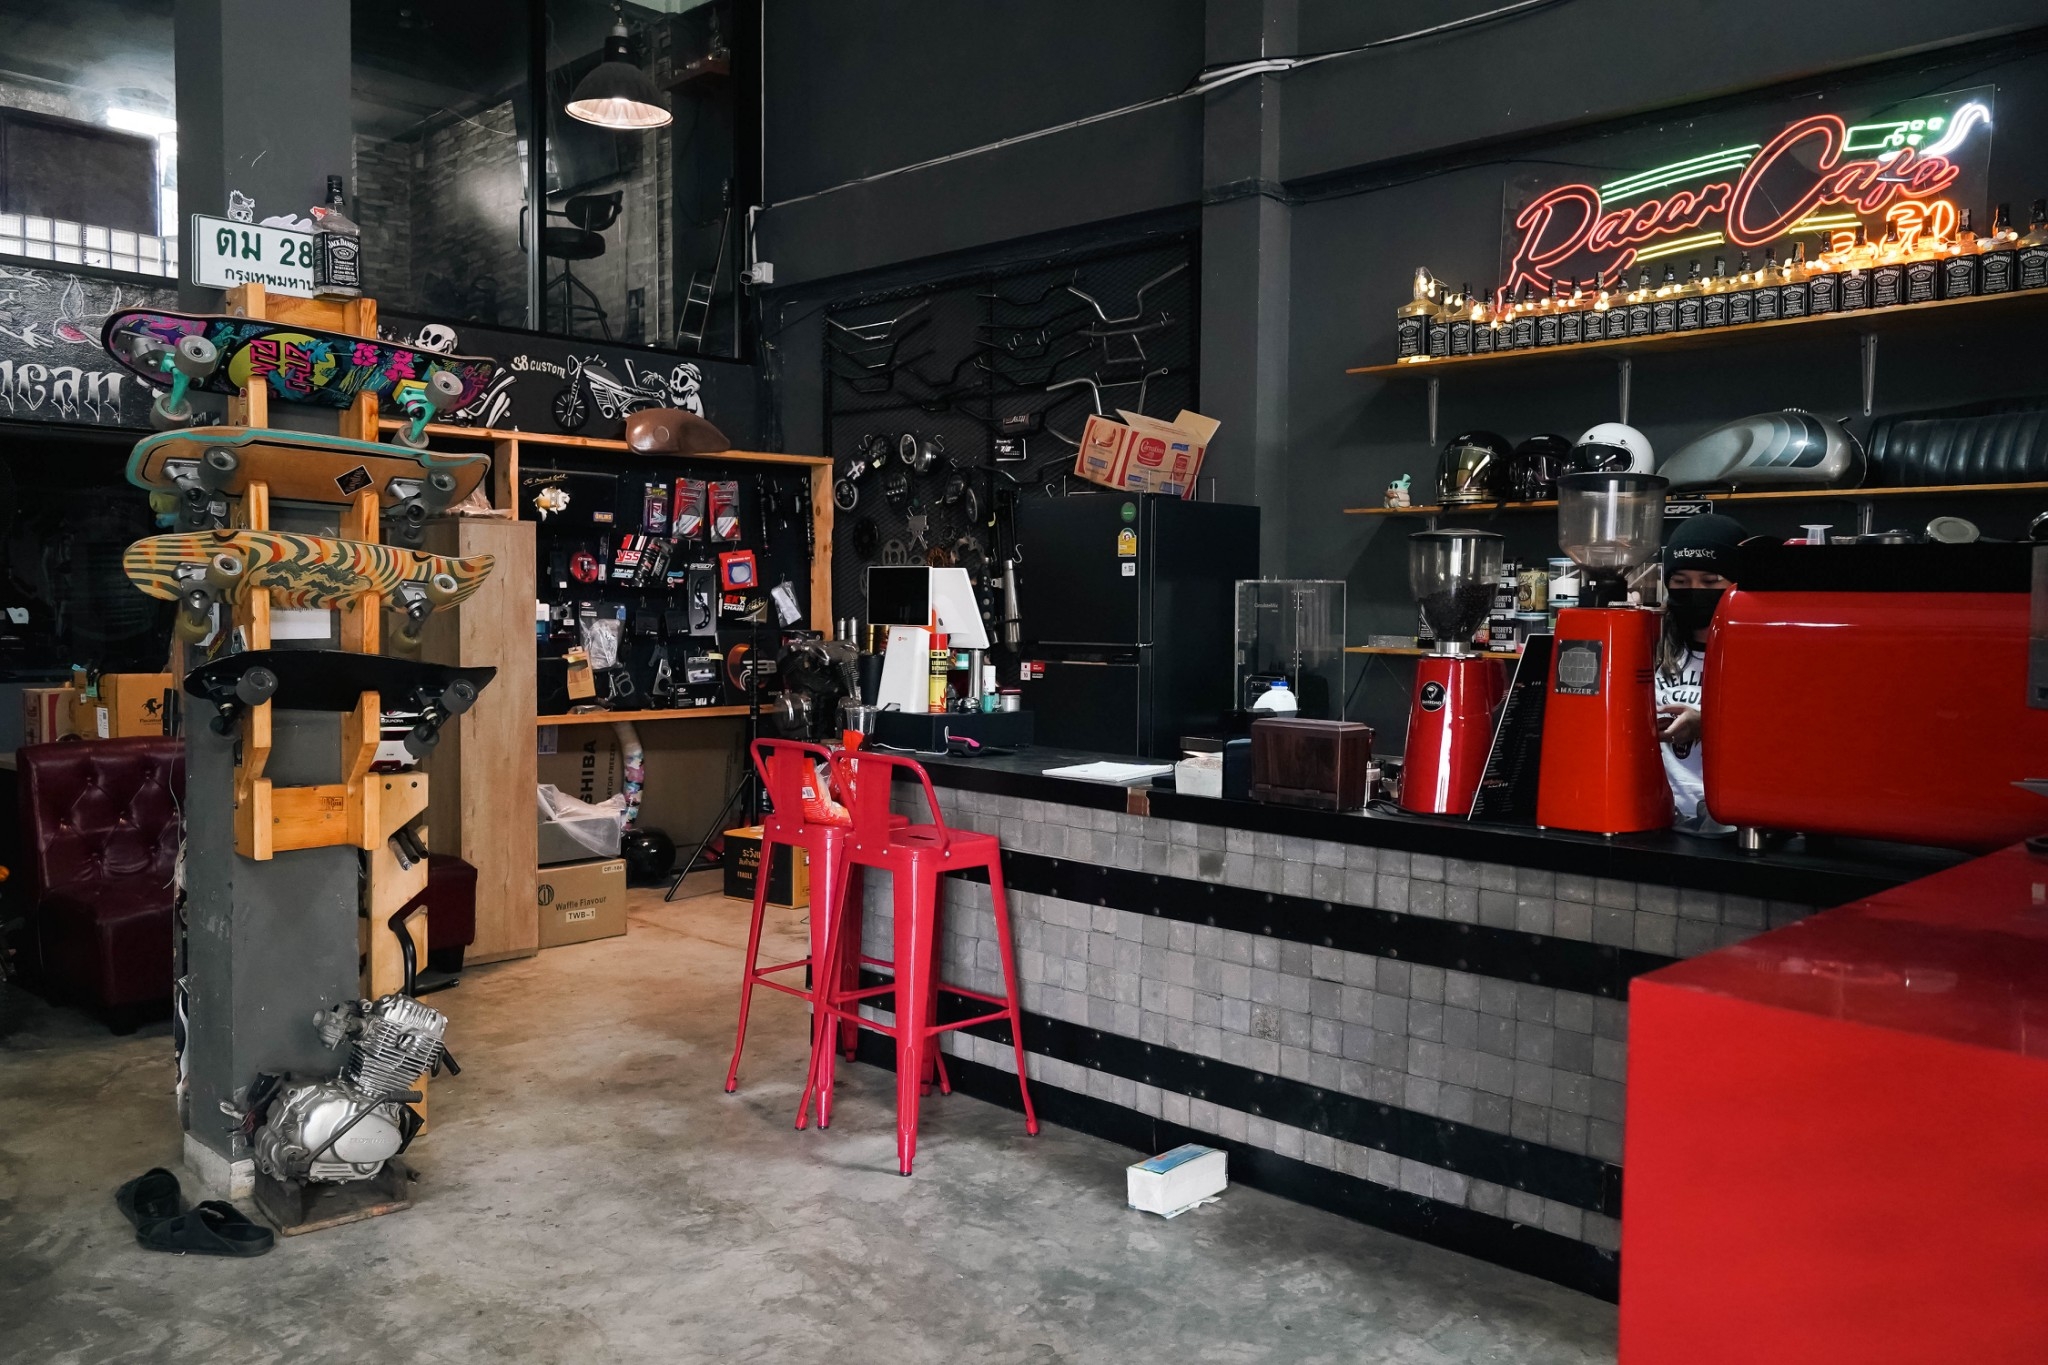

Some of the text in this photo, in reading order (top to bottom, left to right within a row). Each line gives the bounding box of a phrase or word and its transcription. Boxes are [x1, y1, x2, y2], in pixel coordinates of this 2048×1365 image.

[216, 227, 314, 269] ตม 28
[1664, 504, 1704, 514] GPX
[616, 550, 642, 562] YSS
[1672, 690, 1702, 704] CLU
[556, 896, 606, 911] Waffle Flavour
[568, 910, 594, 920] TWB-1
